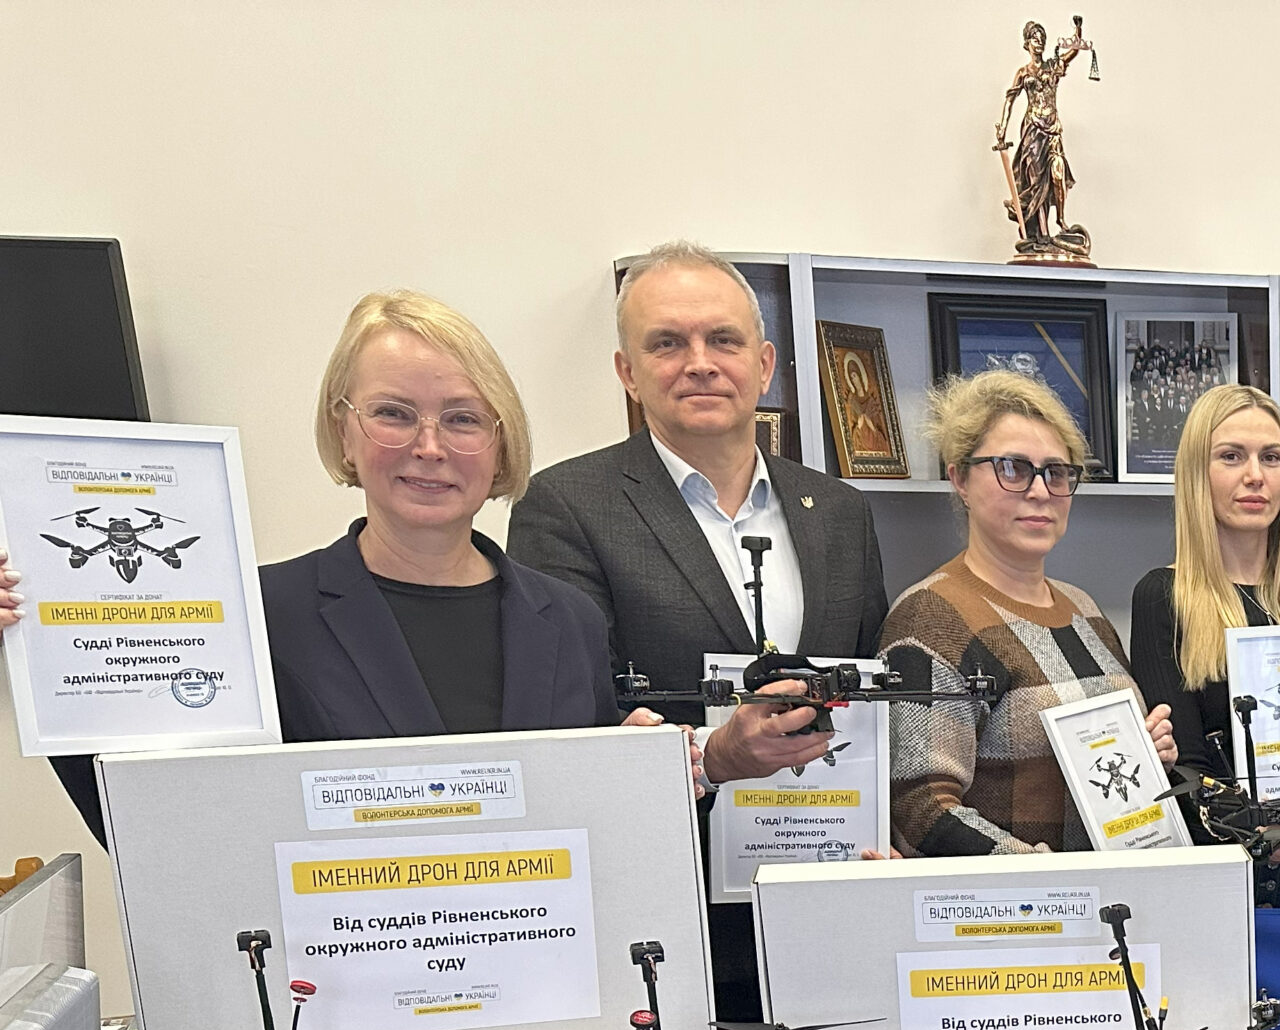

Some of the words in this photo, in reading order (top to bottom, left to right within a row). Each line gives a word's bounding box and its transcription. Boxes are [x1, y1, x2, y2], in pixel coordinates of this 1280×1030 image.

[52, 470, 118, 481] ВІДПОВІДАЛЬНІ
[134, 472, 172, 483] УКРАЇНЦІ
[51, 608, 97, 620] ІМЕННІ
[102, 608, 147, 621] ДРОНИ
[151, 607, 175, 620] ДЛЯ
[180, 604, 213, 619] АРМІЇ
[73, 638, 112, 650] Судді
[116, 637, 205, 648] Рівненського
[106, 655, 180, 667] окружного
[63, 672, 191, 685] адміністративного
[196, 671, 224, 681] суду
[322, 785, 424, 803] ВІДПОВІДАЛЬНІ
[450, 779, 506, 796] УКРАЇНЦІ
[743, 795, 773, 803] ІМЕННІ
[777, 795, 807, 804] ДРОНИ
[810, 795, 827, 804] ДЛЯ
[830, 793, 853, 803] АРМІЇ
[362, 809, 415, 819] ВОЛОНТЕРСЬКА
[417, 807, 453, 816] ДОПОМОГА
[456, 805, 473, 813] АРМІЇ
[755, 817, 781, 826] Судді
[784, 816, 845, 824] Рівненського
[745, 842, 832, 851] адміністративного
[312, 863, 400, 888] ІМЕННИЙ
[408, 862, 457, 884] ДРОН
[464, 860, 498, 882] ДЛЯ
[506, 854, 554, 877] АРМІЇ
[930, 906, 1015, 919] ВІДПОВІДАЛЬНІ
[1037, 902, 1086, 915] УКРАЇНЦІ
[333, 916, 363, 932] Від
[368, 912, 426, 933] суддів
[432, 905, 547, 925] Рівненського
[1041, 924, 1056, 932] АРМІЇ
[306, 939, 407, 957] окружного
[413, 926, 576, 950] адміністративного
[427, 957, 466, 972] суду
[926, 971, 999, 992] ІМЕННИЙ
[1005, 973, 1047, 991] ДРОН
[1053, 971, 1084, 990] ДЛЯ
[1089, 969, 1125, 986] АРМІ
[398, 995, 452, 1006] ВІДПОВІДАЛЬНІ
[466, 990, 496, 1000] УКРАЇНЦІ
[942, 1017, 966, 1030] Від
[970, 1016, 1019, 1030] суддів
[1024, 1012, 1122, 1026] Рівненського
